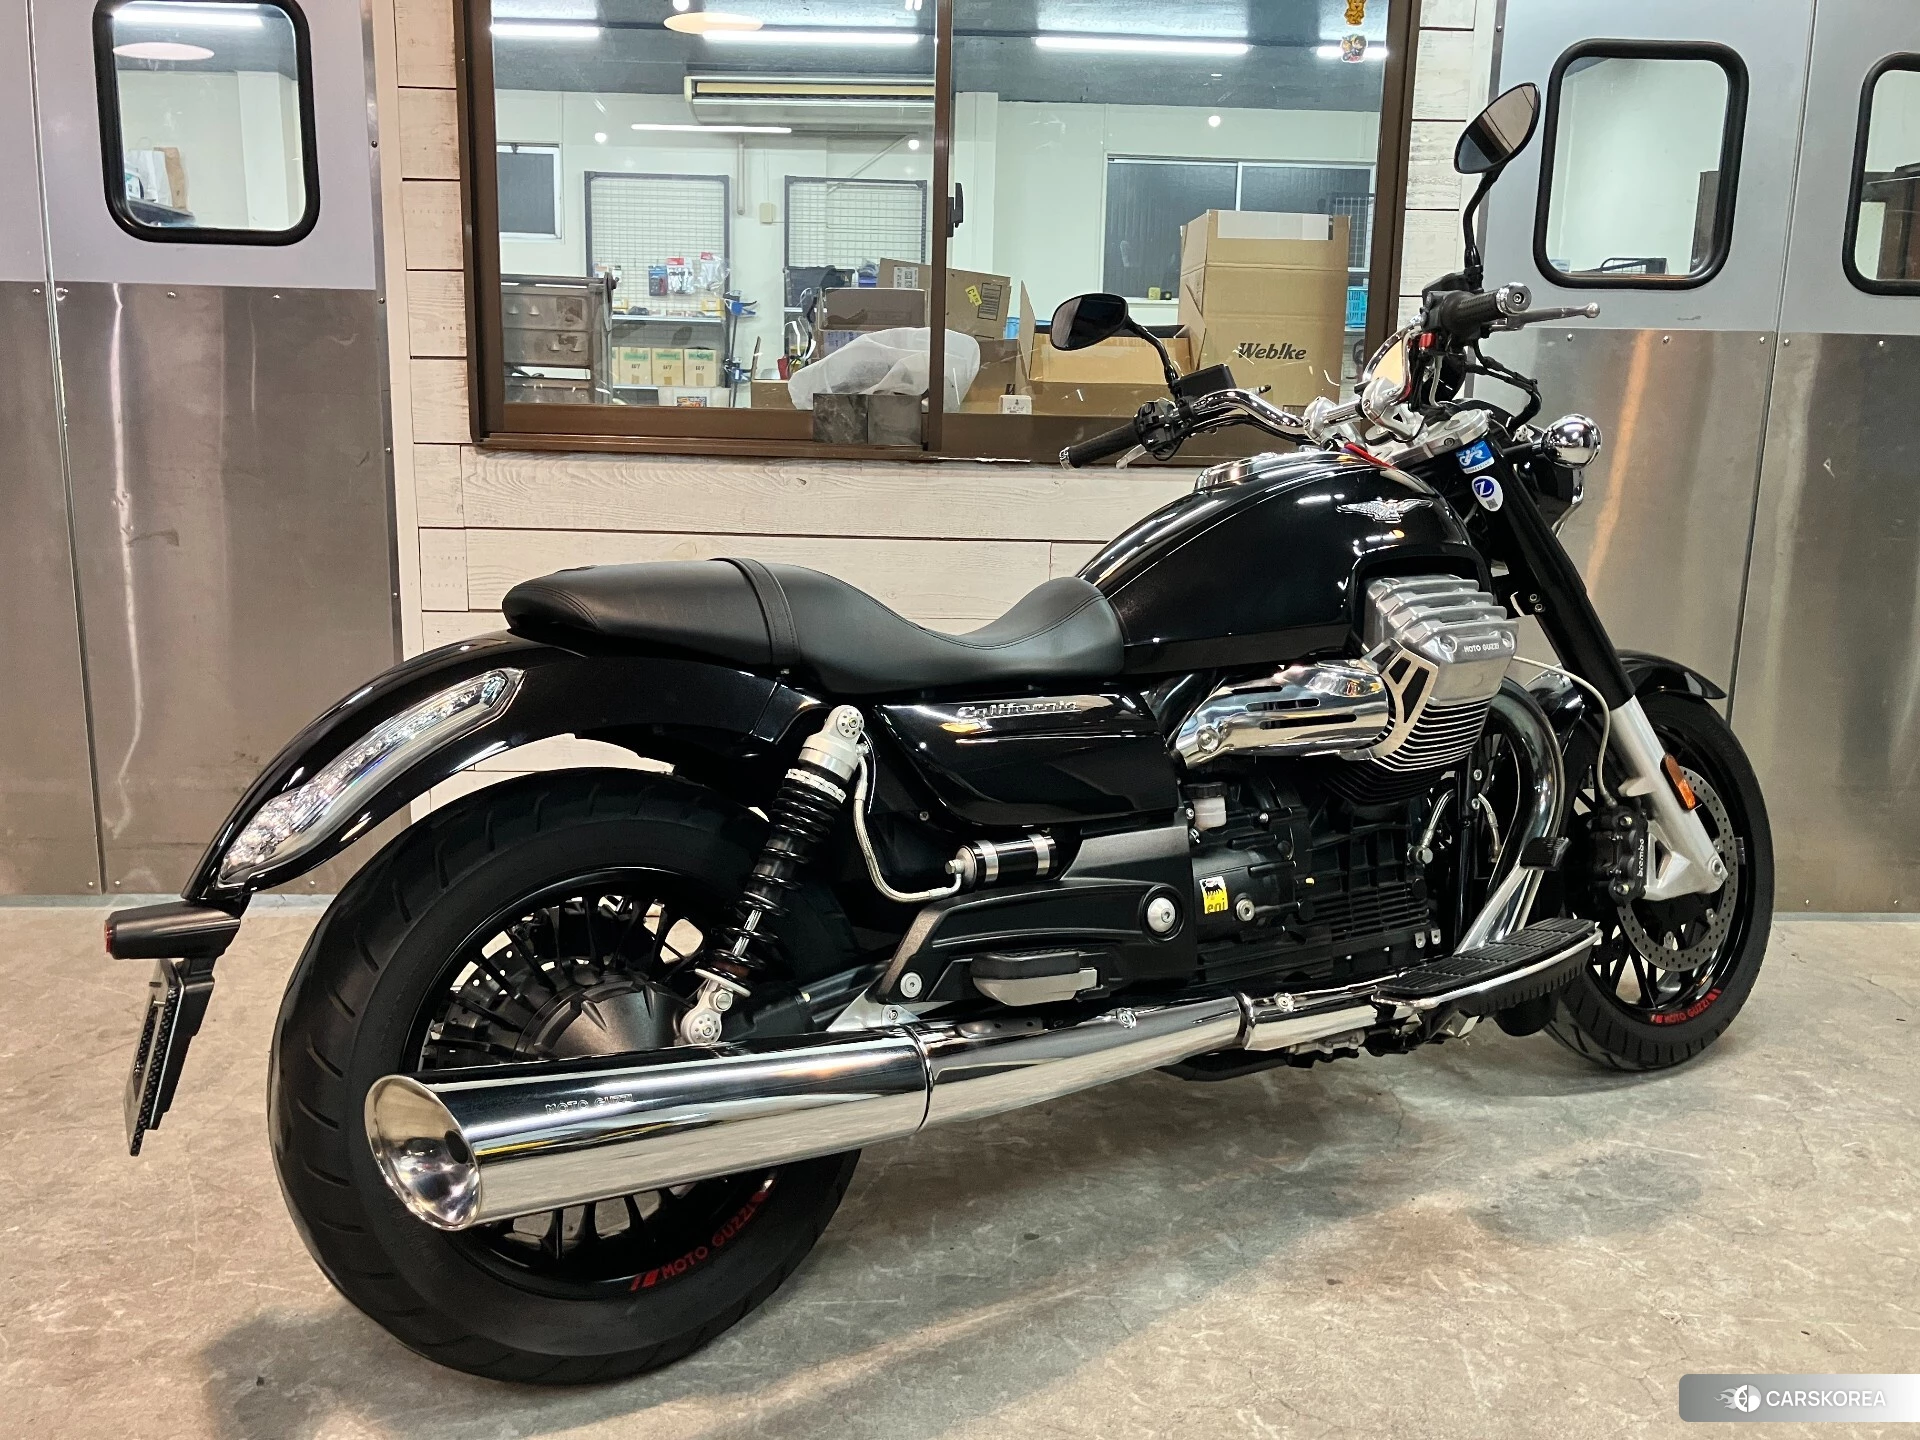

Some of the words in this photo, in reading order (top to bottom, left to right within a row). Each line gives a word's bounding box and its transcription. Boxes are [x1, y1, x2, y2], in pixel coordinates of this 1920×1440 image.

[1463, 644, 1482, 653] MOTO
[1636, 838, 1645, 877] brembo
[544, 1099, 589, 1116] MOTO
[661, 1246, 708, 1280] MOTO
[711, 1201, 758, 1248] GUZZI
